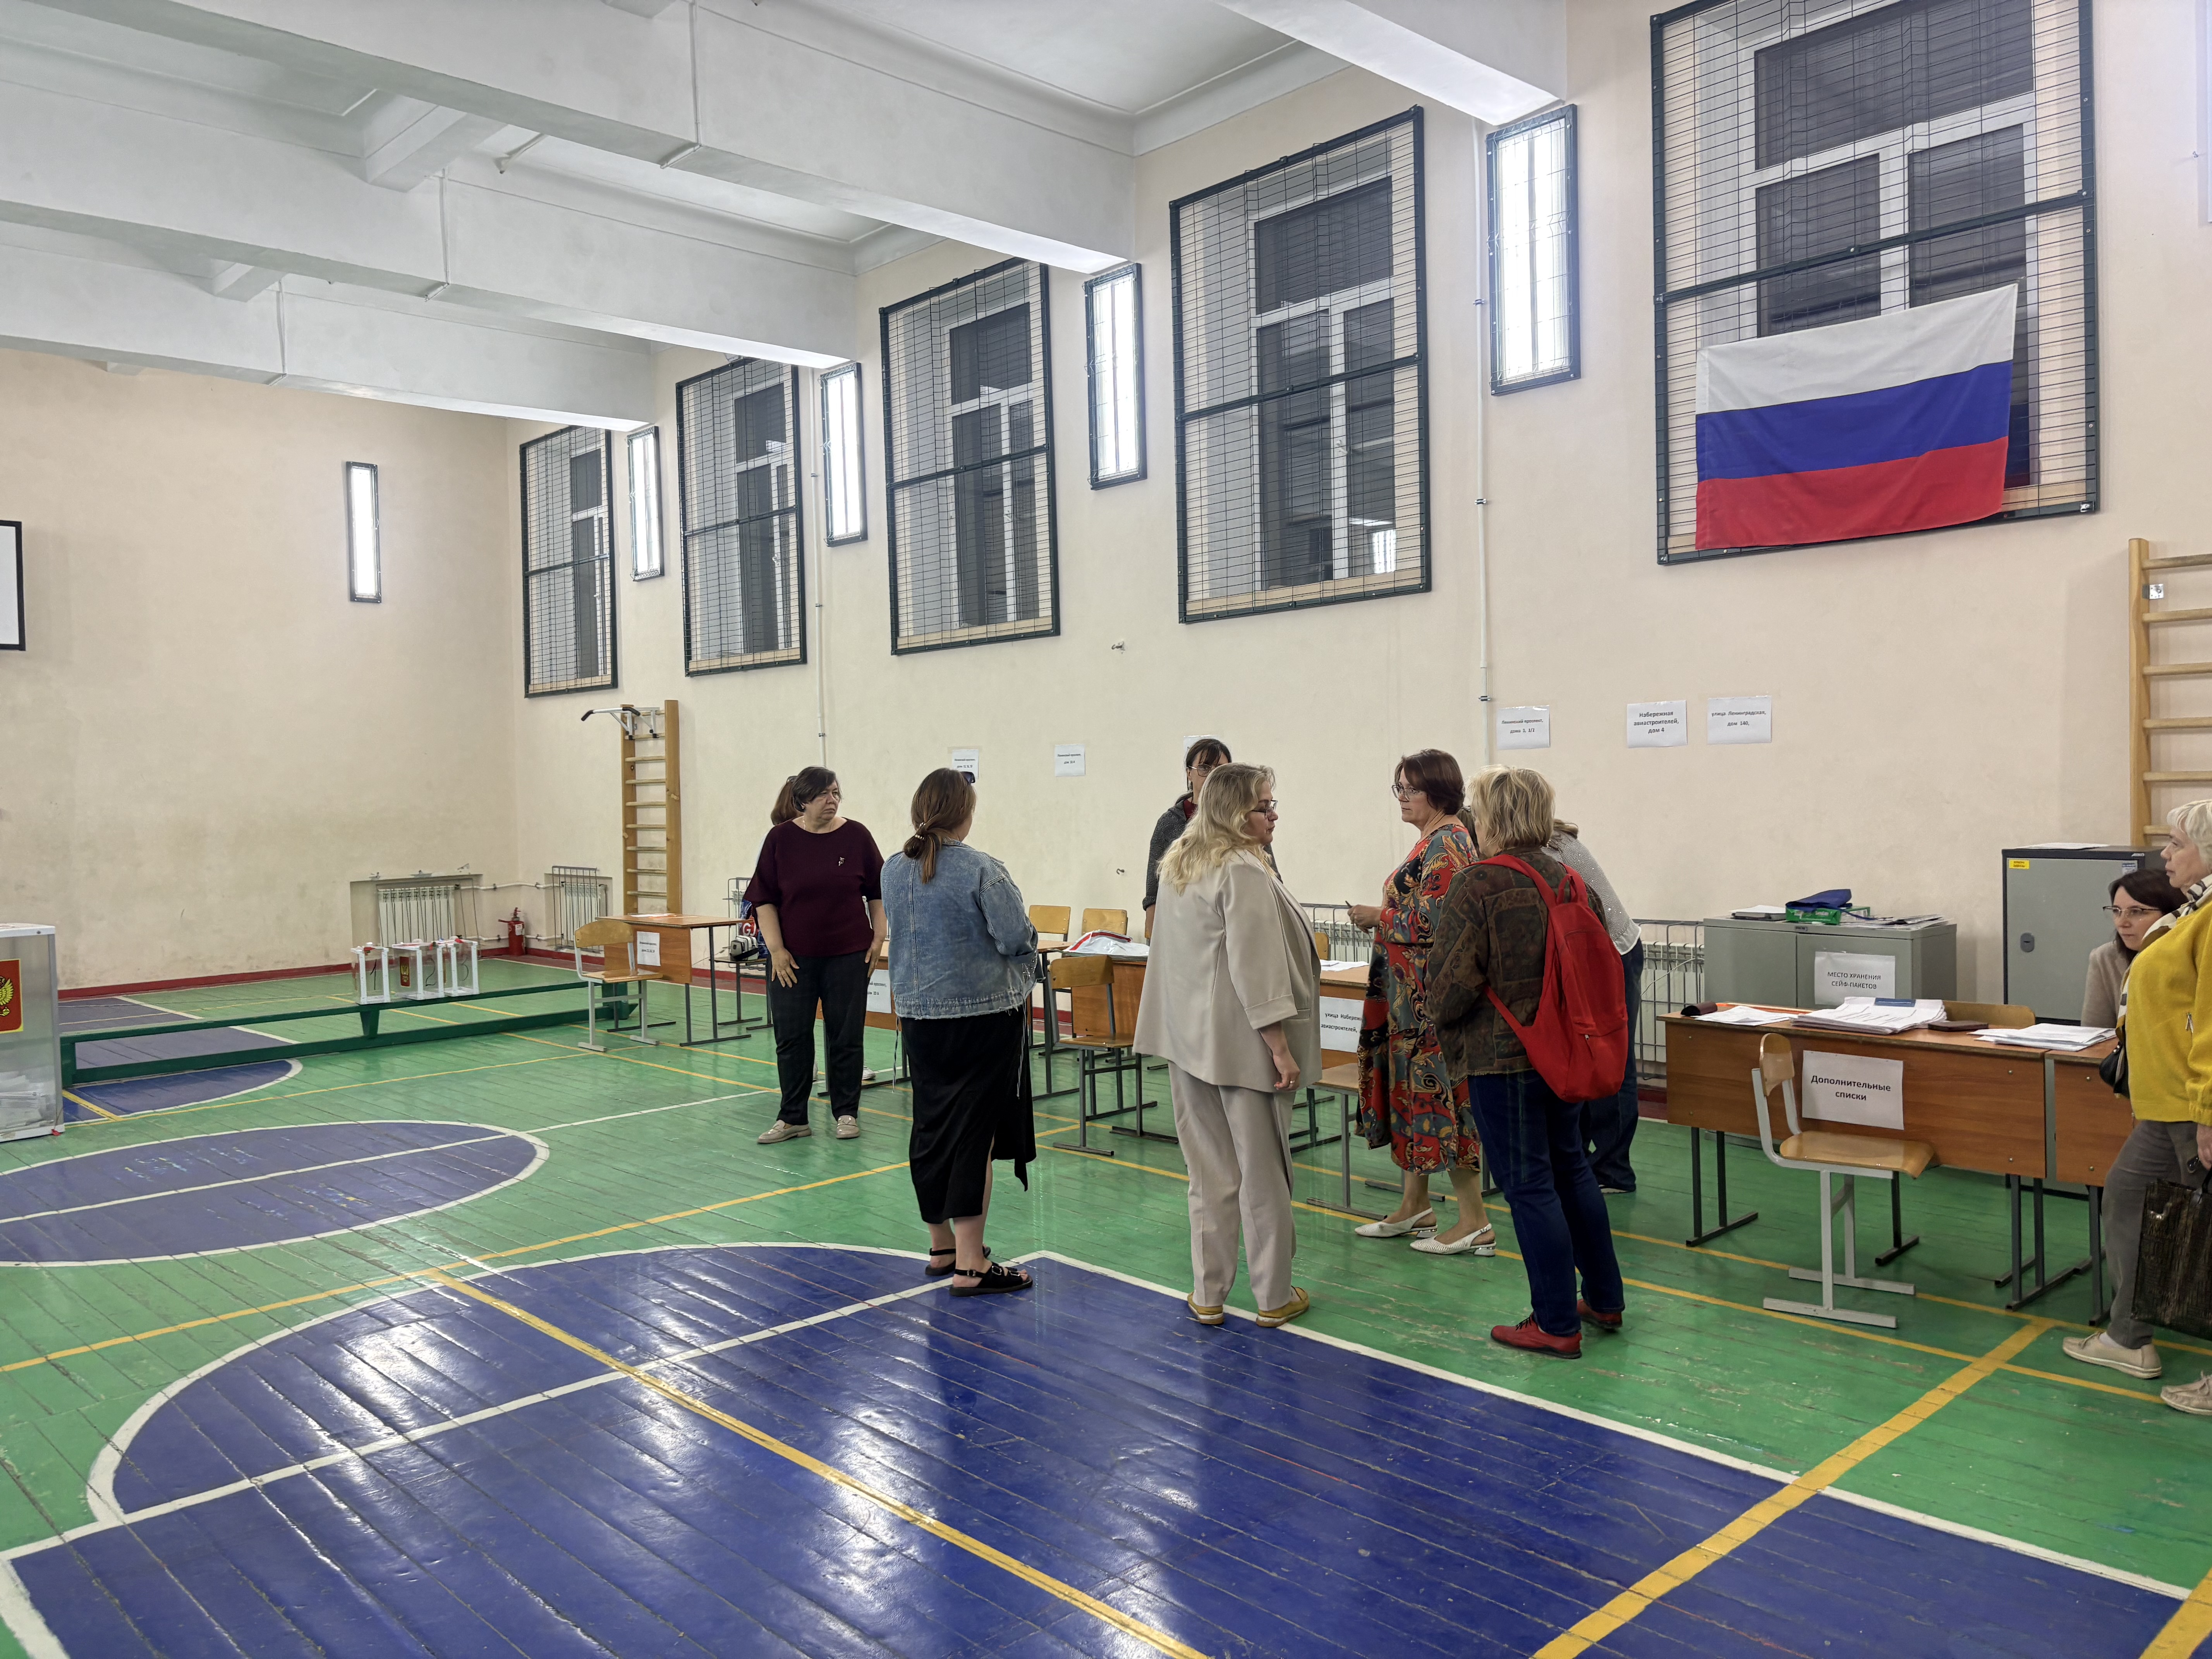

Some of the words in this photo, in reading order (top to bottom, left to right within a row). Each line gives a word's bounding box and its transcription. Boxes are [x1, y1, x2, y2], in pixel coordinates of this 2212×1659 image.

[1831, 981, 1877, 989] СЕЙФ-ПАКЕТОВ
[1321, 1024, 1357, 1033] авиастроителей,
[1811, 1075, 1891, 1091] Дополнительные
[1835, 1091, 1867, 1101] списки
